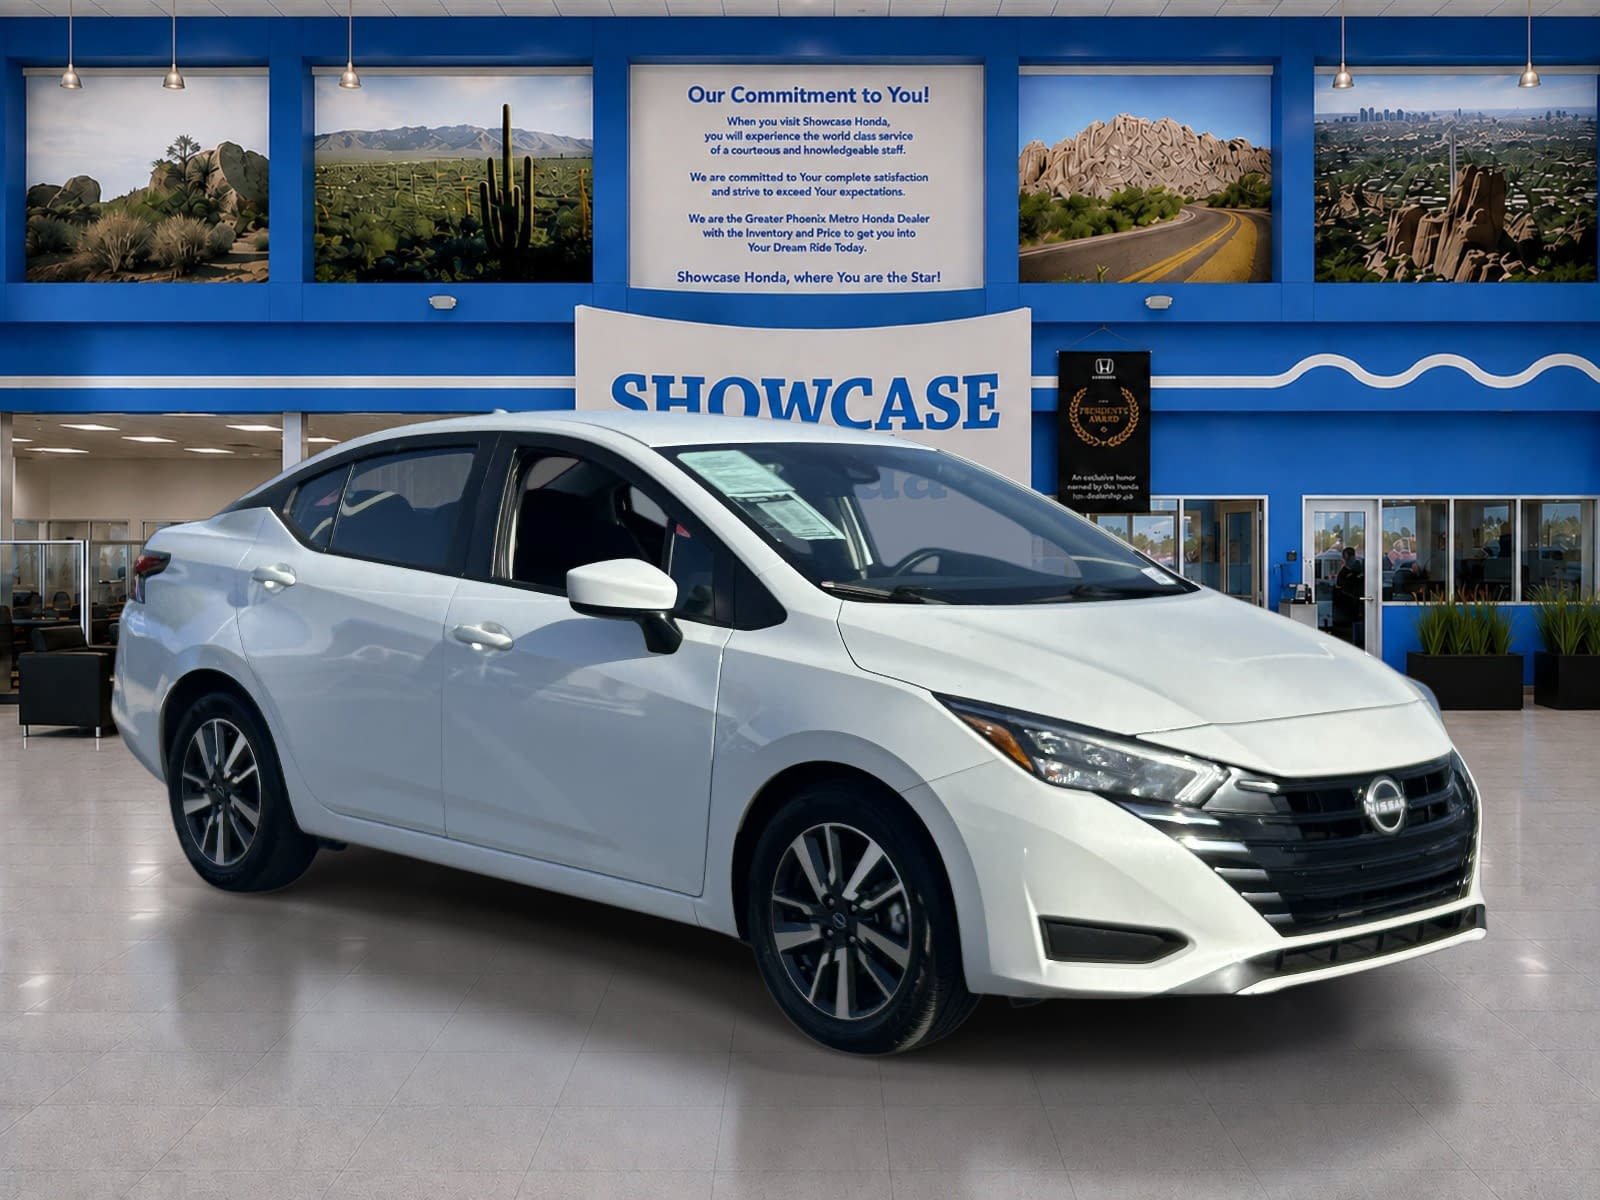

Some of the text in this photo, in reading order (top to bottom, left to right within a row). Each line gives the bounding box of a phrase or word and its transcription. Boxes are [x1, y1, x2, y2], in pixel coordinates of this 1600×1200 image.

[687, 85, 929, 104] Our Commitment to You!
[726, 116, 891, 129] When you visit Showcase Honda,
[704, 130, 914, 144] you will experience the world class service
[710, 144, 721, 155] of
[722, 147, 730, 155] a
[730, 146, 781, 156] courteous
[782, 144, 802, 155] and
[689, 171, 929, 185] We are committed to Your complete satisfaction
[711, 185, 906, 200] and strive to exceed Your expectations.
[688, 213, 931, 224] We are the Greater Phoenix Metro Honda Dealer
[702, 227, 917, 241] with the Inventory and Price to get you into
[747, 242, 867, 255] Your Dream Ride Today.
[677, 270, 941, 286] Showcase Honda, where You are the Star!
[611, 372, 1000, 430] SHOWCASE
